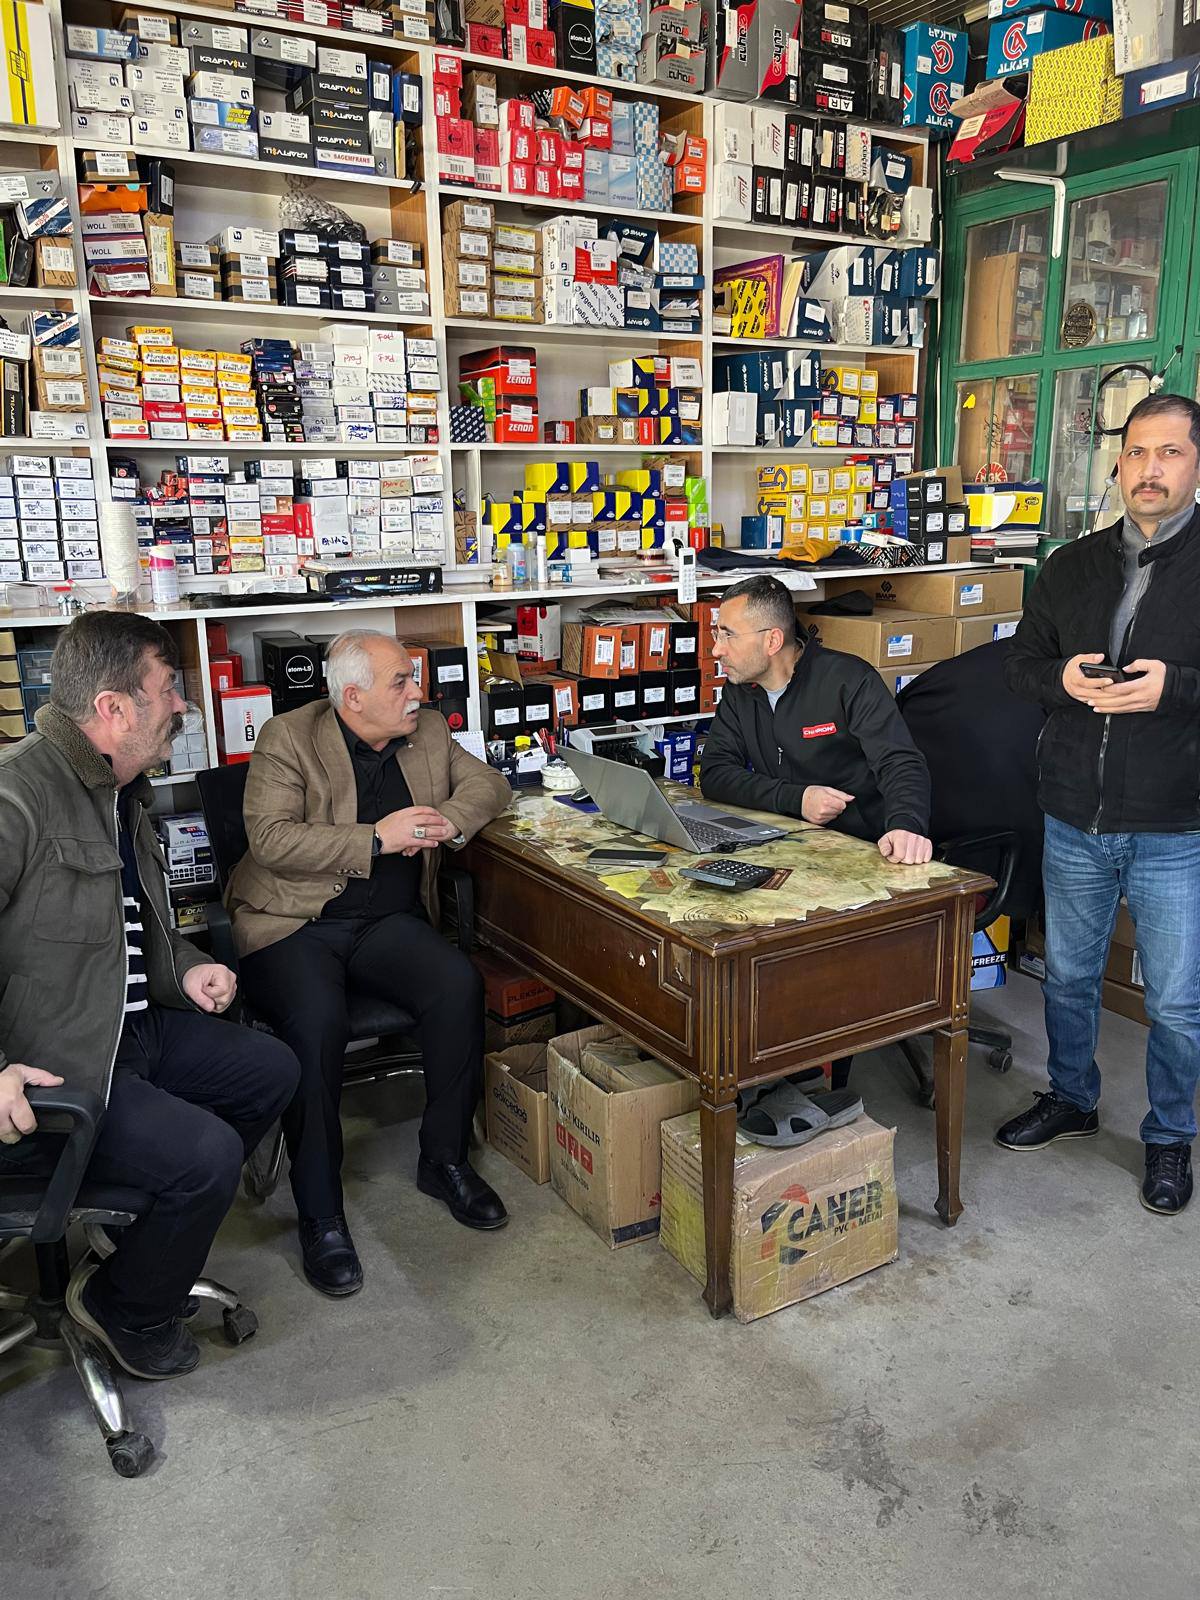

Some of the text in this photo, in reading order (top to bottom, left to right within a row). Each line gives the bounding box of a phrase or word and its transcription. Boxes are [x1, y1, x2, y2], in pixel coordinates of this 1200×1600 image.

[821, 31, 851, 47] ART
[928, 28, 957, 42] ALKAR
[997, 58, 1029, 75] ALKAR
[319, 83, 363, 95] KRAFTVOLL
[816, 94, 851, 113] ART
[926, 115, 953, 129] ALKAR
[317, 136, 362, 147] KRAFTVOLL
[506, 375, 532, 385] ZENON
[508, 423, 534, 433] ZENON
[981, 472, 1002, 483] NGK
[389, 573, 421, 584] HID
[573, 1113, 601, 1147] KIRILIR
[788, 1181, 883, 1242] CANER
[834, 1222, 849, 1236] PVC
